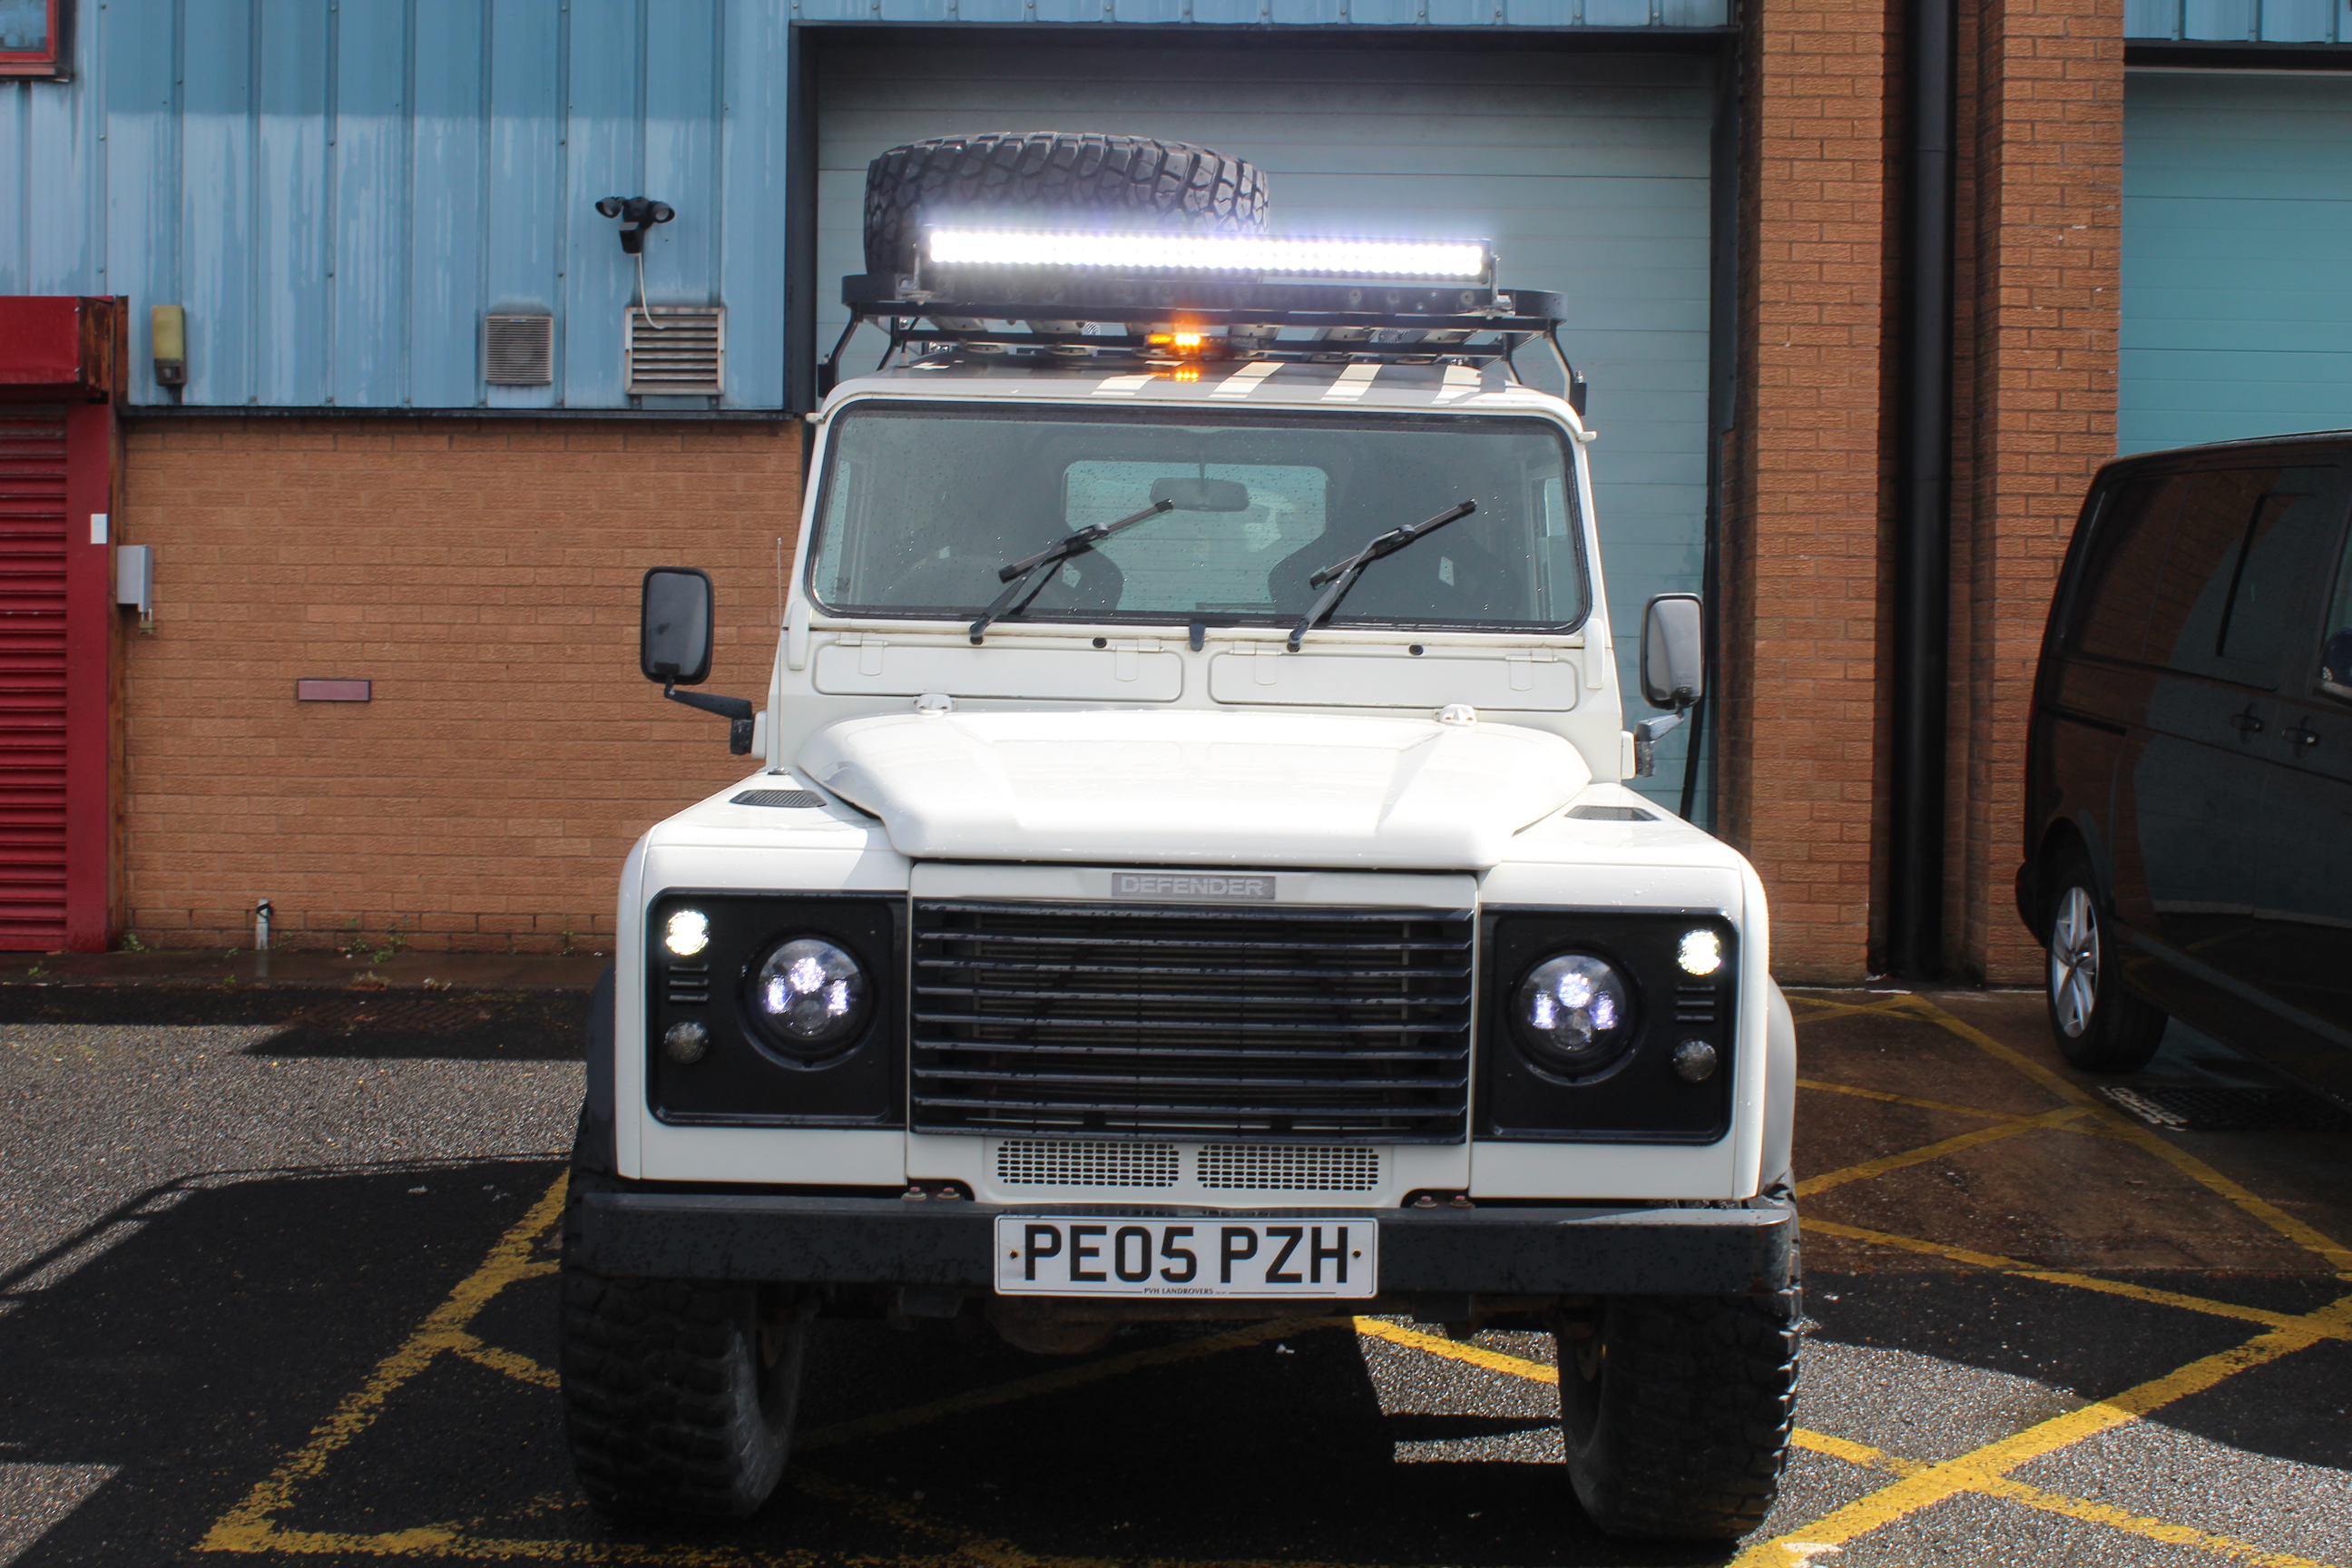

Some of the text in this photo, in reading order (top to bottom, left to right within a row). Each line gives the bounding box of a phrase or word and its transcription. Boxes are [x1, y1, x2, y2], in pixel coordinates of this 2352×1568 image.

[1121, 876, 1264, 896] DEFENDER
[1024, 1224, 1348, 1284] PE05 PZH
